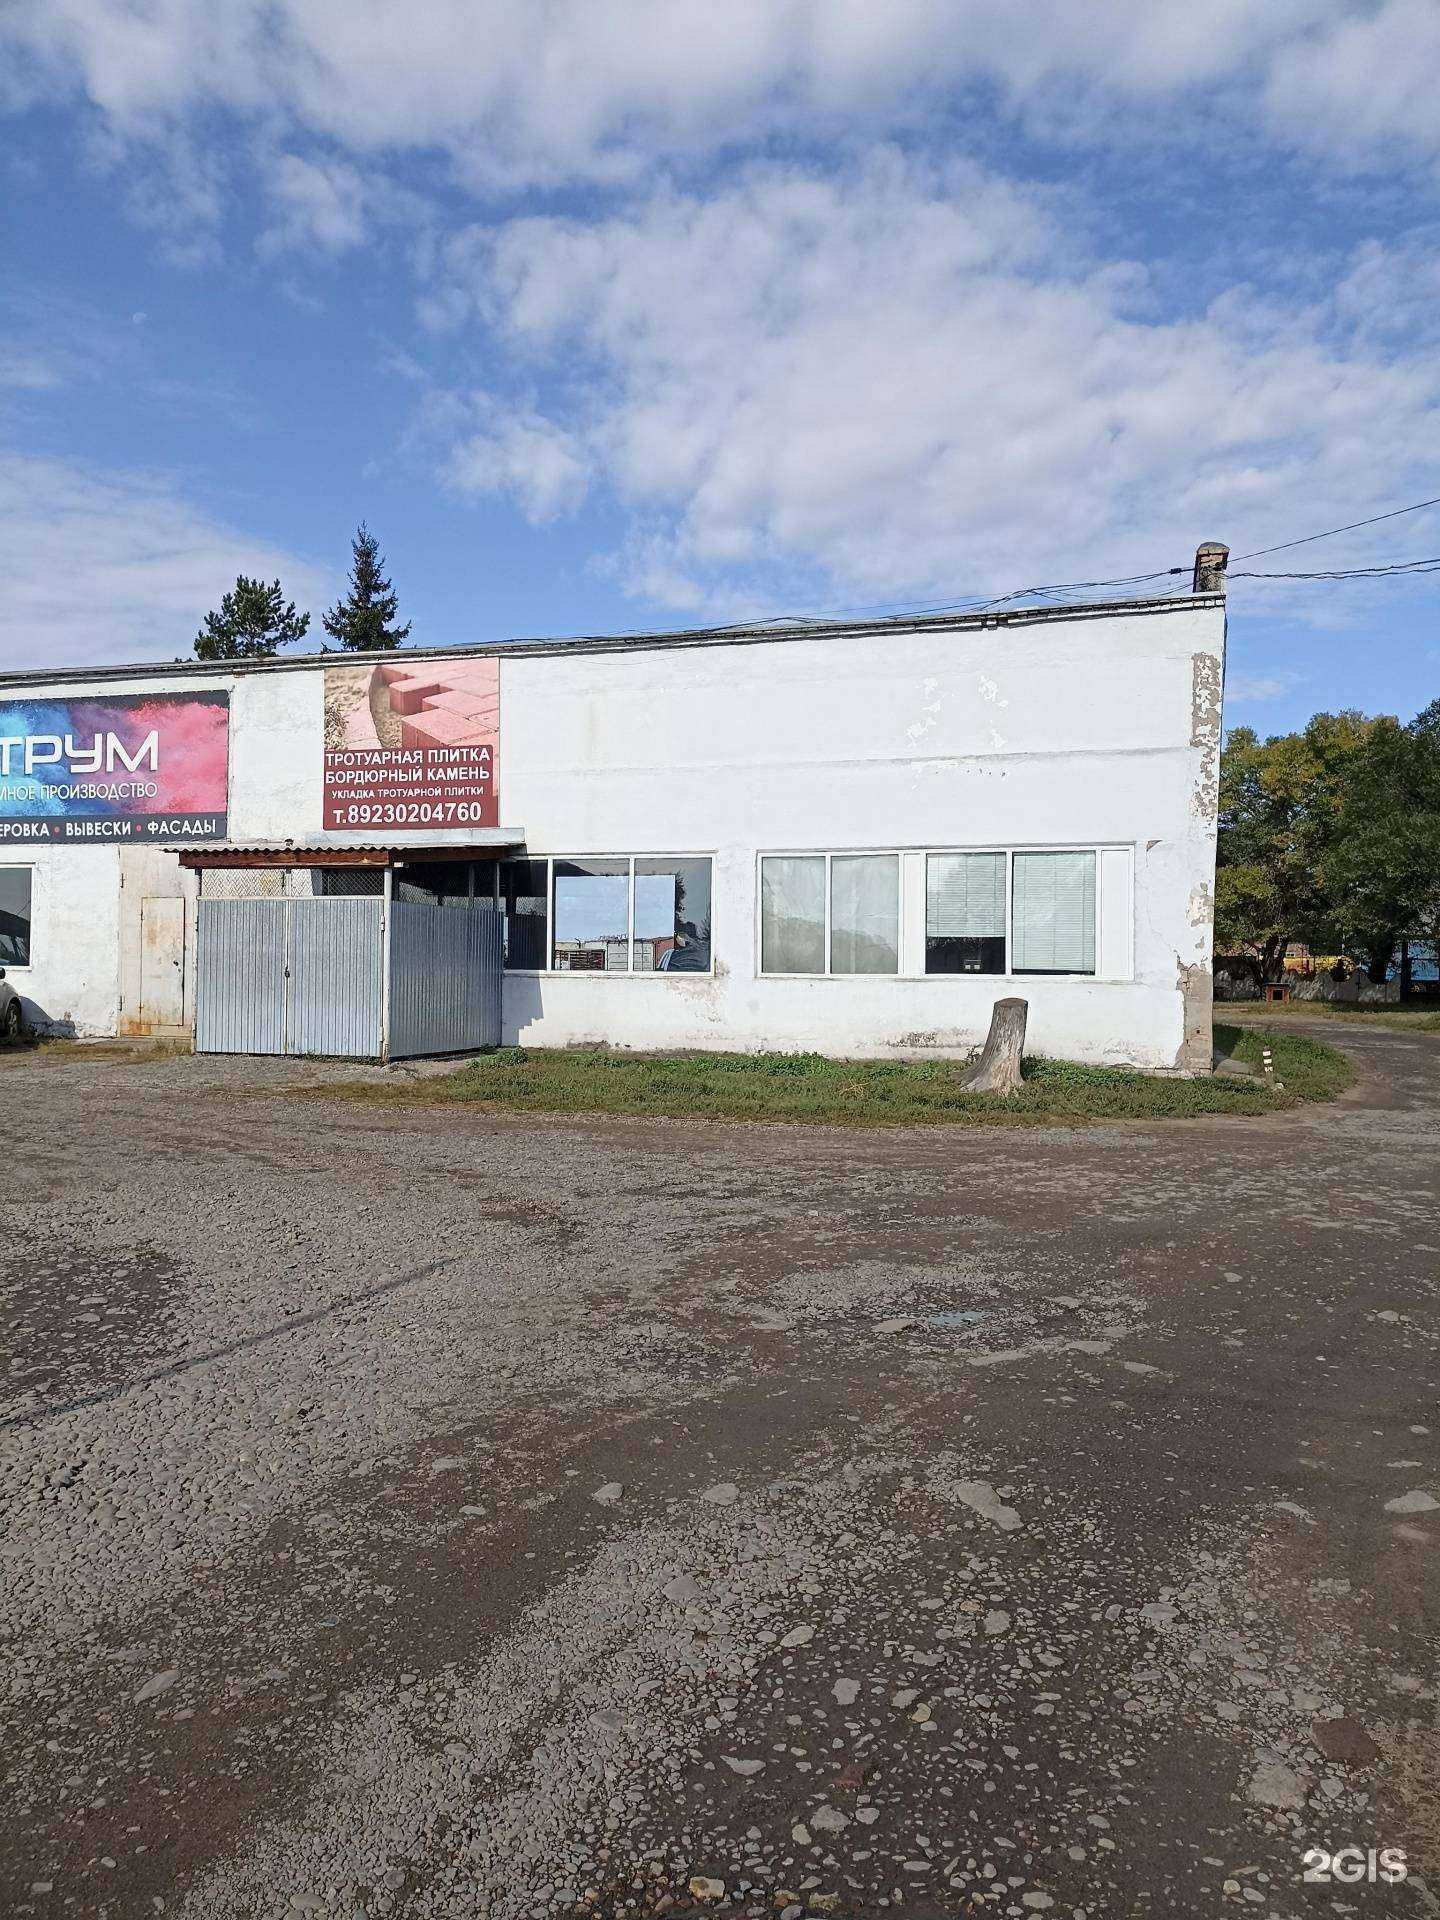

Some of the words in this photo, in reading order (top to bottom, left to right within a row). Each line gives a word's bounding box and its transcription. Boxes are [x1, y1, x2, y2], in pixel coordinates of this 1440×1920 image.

[0, 730, 158, 775] ТРУМ
[326, 751, 422, 766] ТРОТУАРНАЯ
[428, 748, 491, 763] ПЛИТКА
[326, 766, 422, 785] БОРДЮРНЫЙ
[428, 767, 489, 781] КАМЕНЬ
[41, 783, 157, 800] ПРОИЗВОДСТВО
[332, 789, 375, 799] УКЛАДКА
[378, 787, 441, 798] ТРОТУАРНОЙ
[445, 786, 484, 796] ПЛИТКИ
[66, 821, 131, 836] ВЫВЕСКИ
[147, 819, 216, 836] ФАСАДЫ
